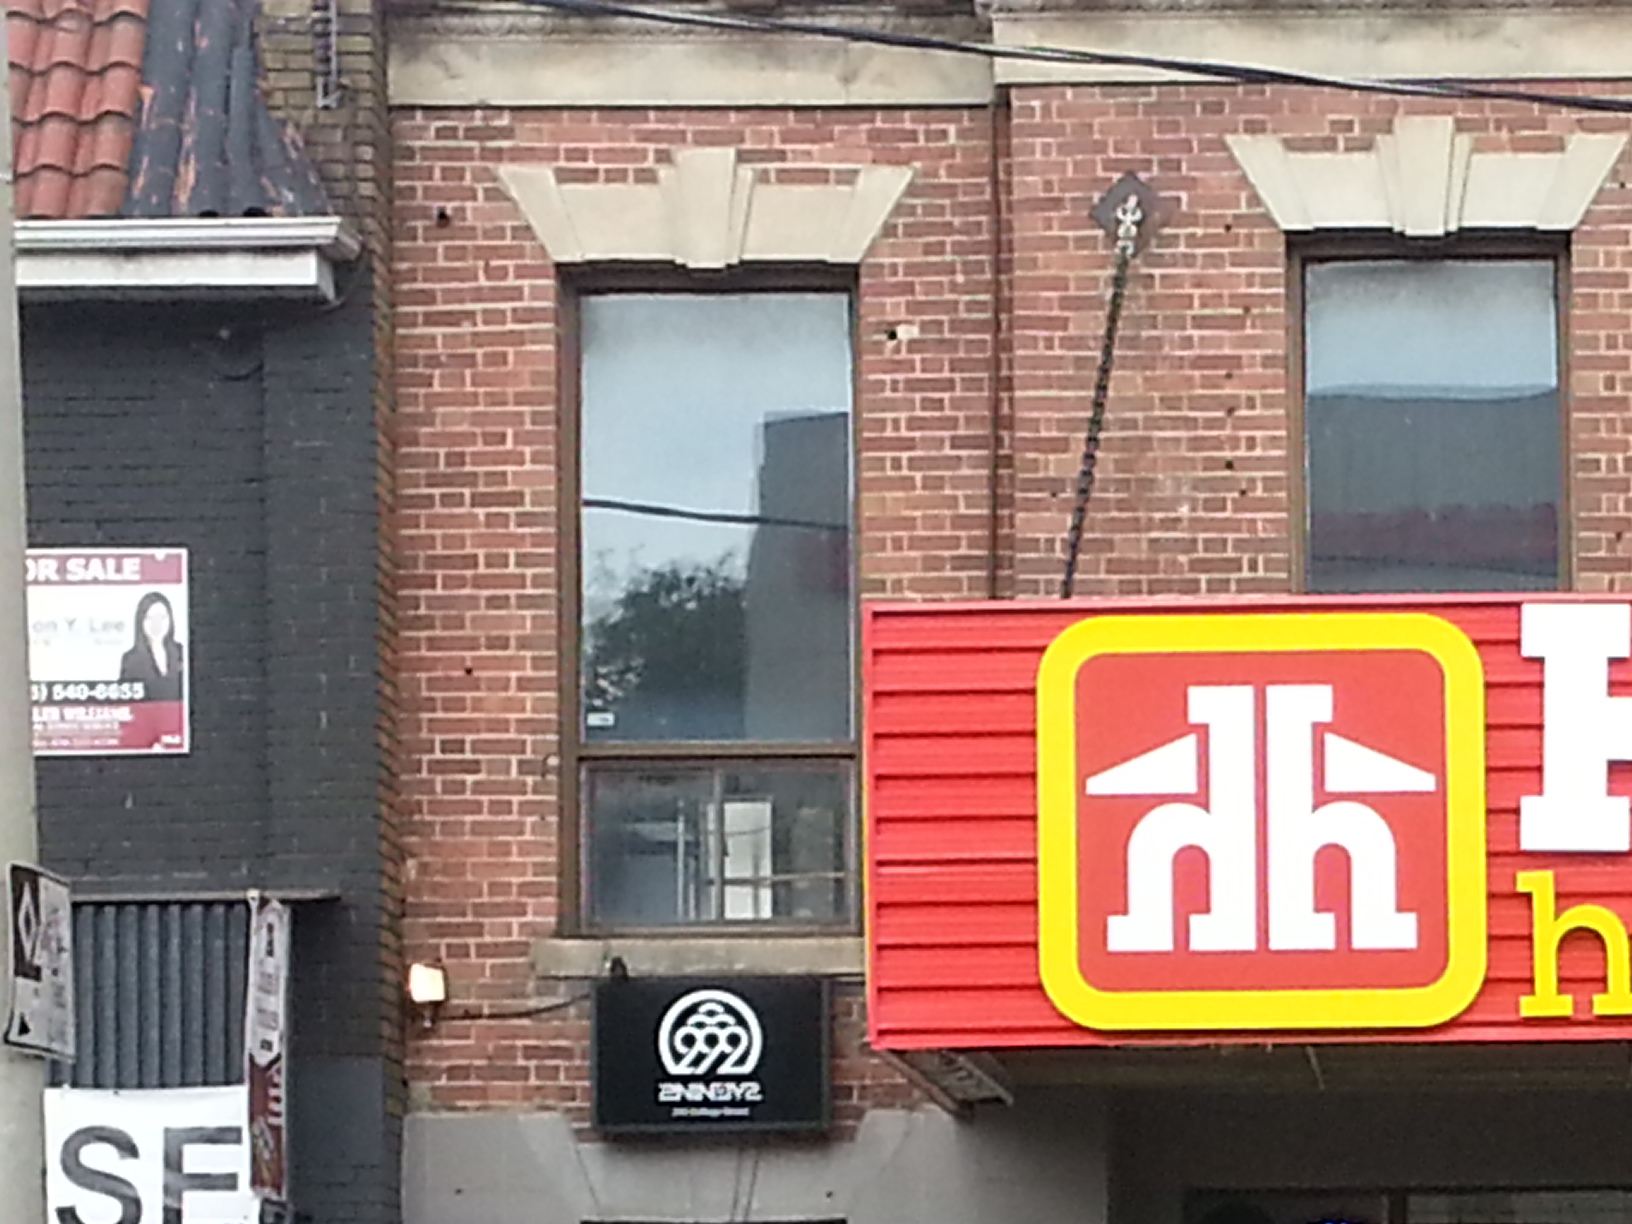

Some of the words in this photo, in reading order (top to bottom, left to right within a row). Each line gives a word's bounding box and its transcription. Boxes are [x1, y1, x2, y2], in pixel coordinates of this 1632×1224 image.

[26, 557, 59, 582] OR
[65, 557, 141, 581] SALE
[88, 616, 126, 634] Lee
